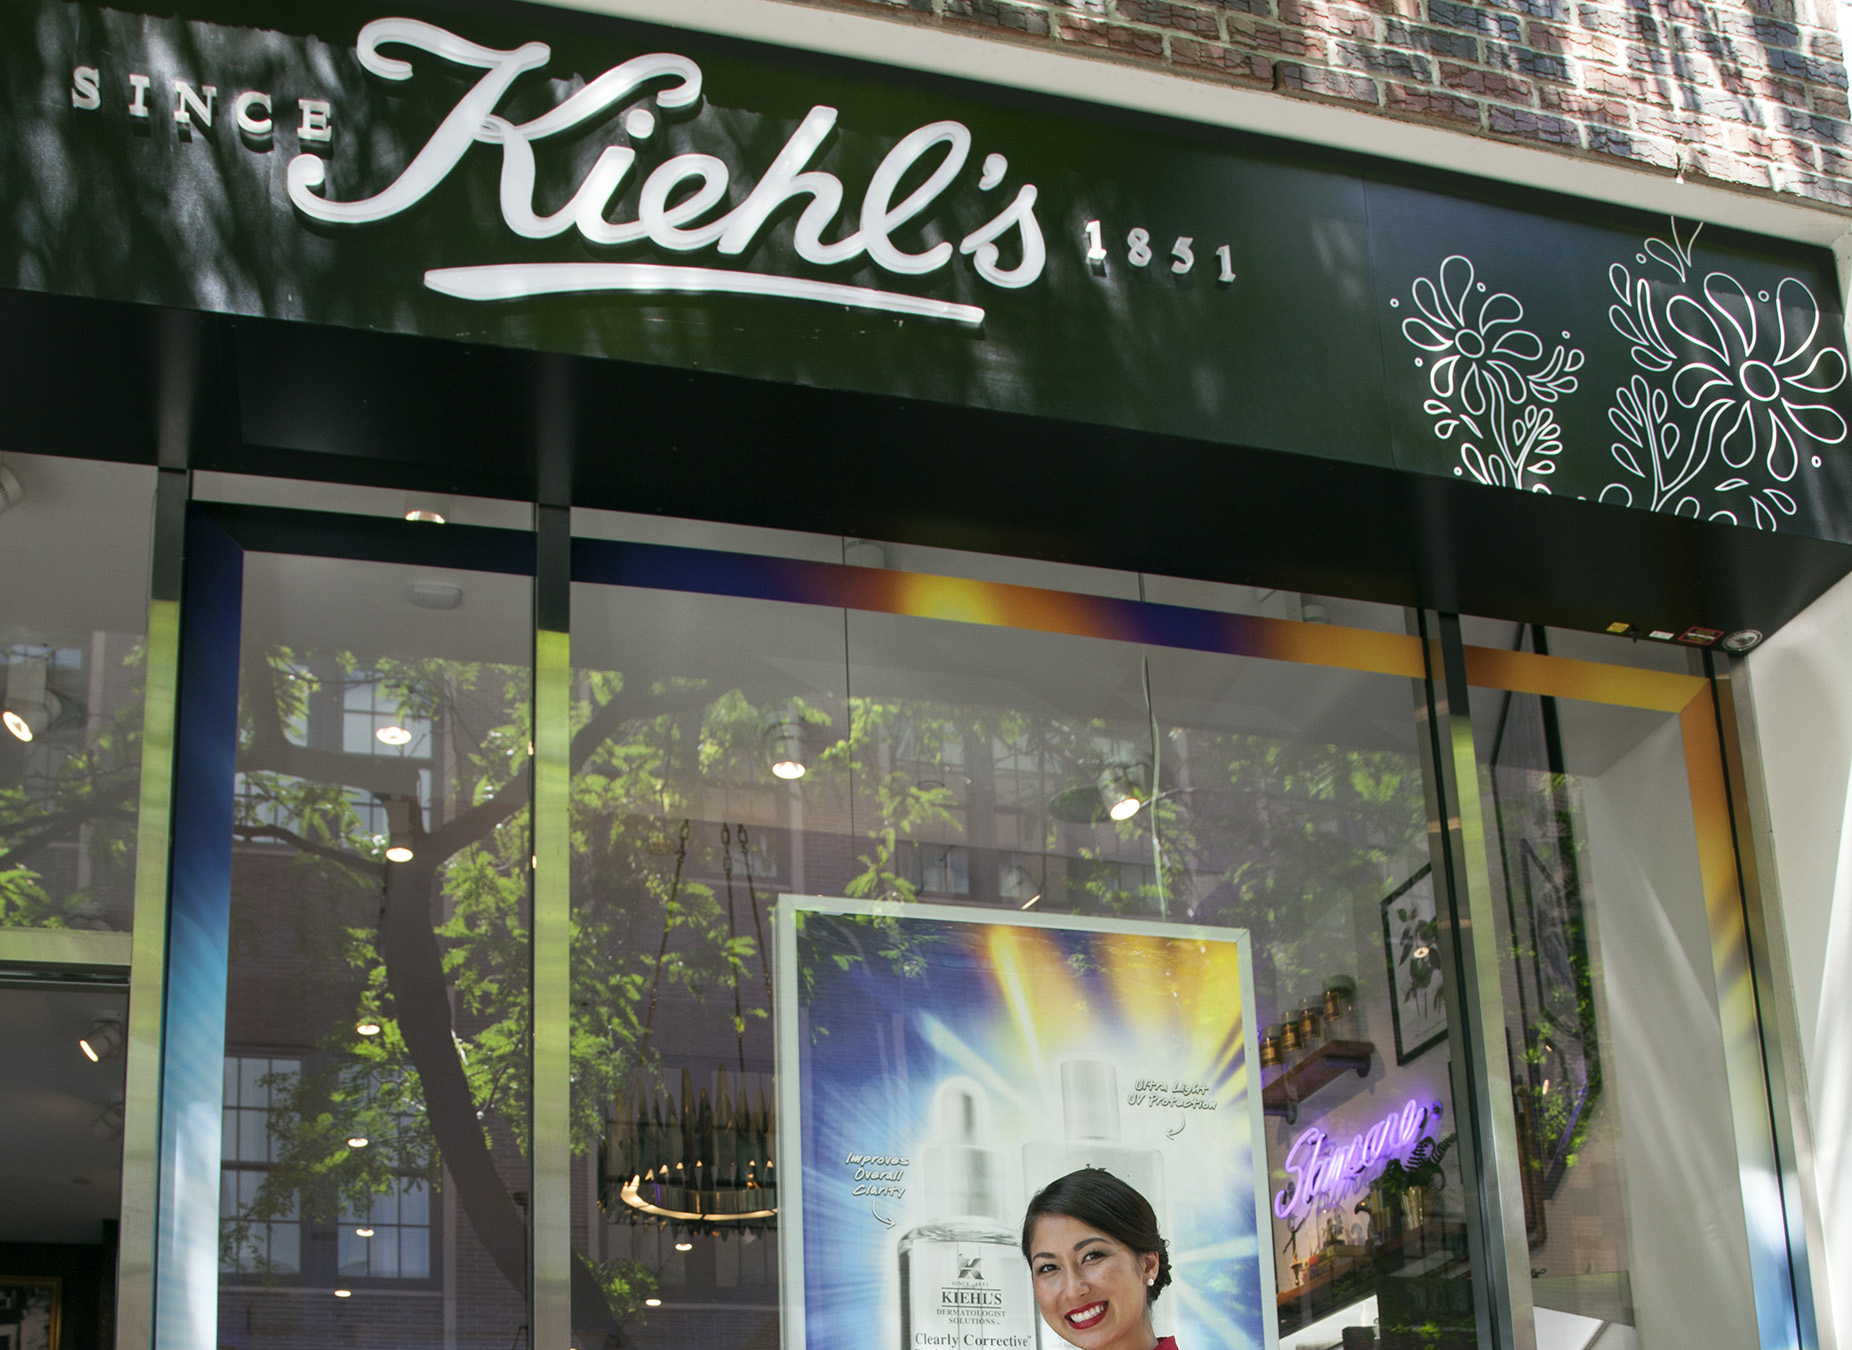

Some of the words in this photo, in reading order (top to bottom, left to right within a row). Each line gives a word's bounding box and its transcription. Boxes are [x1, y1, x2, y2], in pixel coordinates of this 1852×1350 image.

[71, 65, 333, 143] SINCE
[287, 16, 1047, 289] Kiehl's
[1084, 219, 1237, 284] 1851
[1134, 1079, 1168, 1092] Ultra
[1171, 1082, 1209, 1096] Light
[1127, 1093, 1146, 1106] UV
[1148, 1093, 1218, 1110] Protection
[845, 1151, 909, 1167] Improves
[854, 1167, 904, 1181] Overall
[852, 1184, 906, 1199] Clarity
[941, 1291, 1002, 1305] KIEHL'S
[936, 1308, 1006, 1318] DERMATOLOGIST
[948, 1317, 996, 1326] SOLUTIONS
[915, 1333, 959, 1348] Clearly
